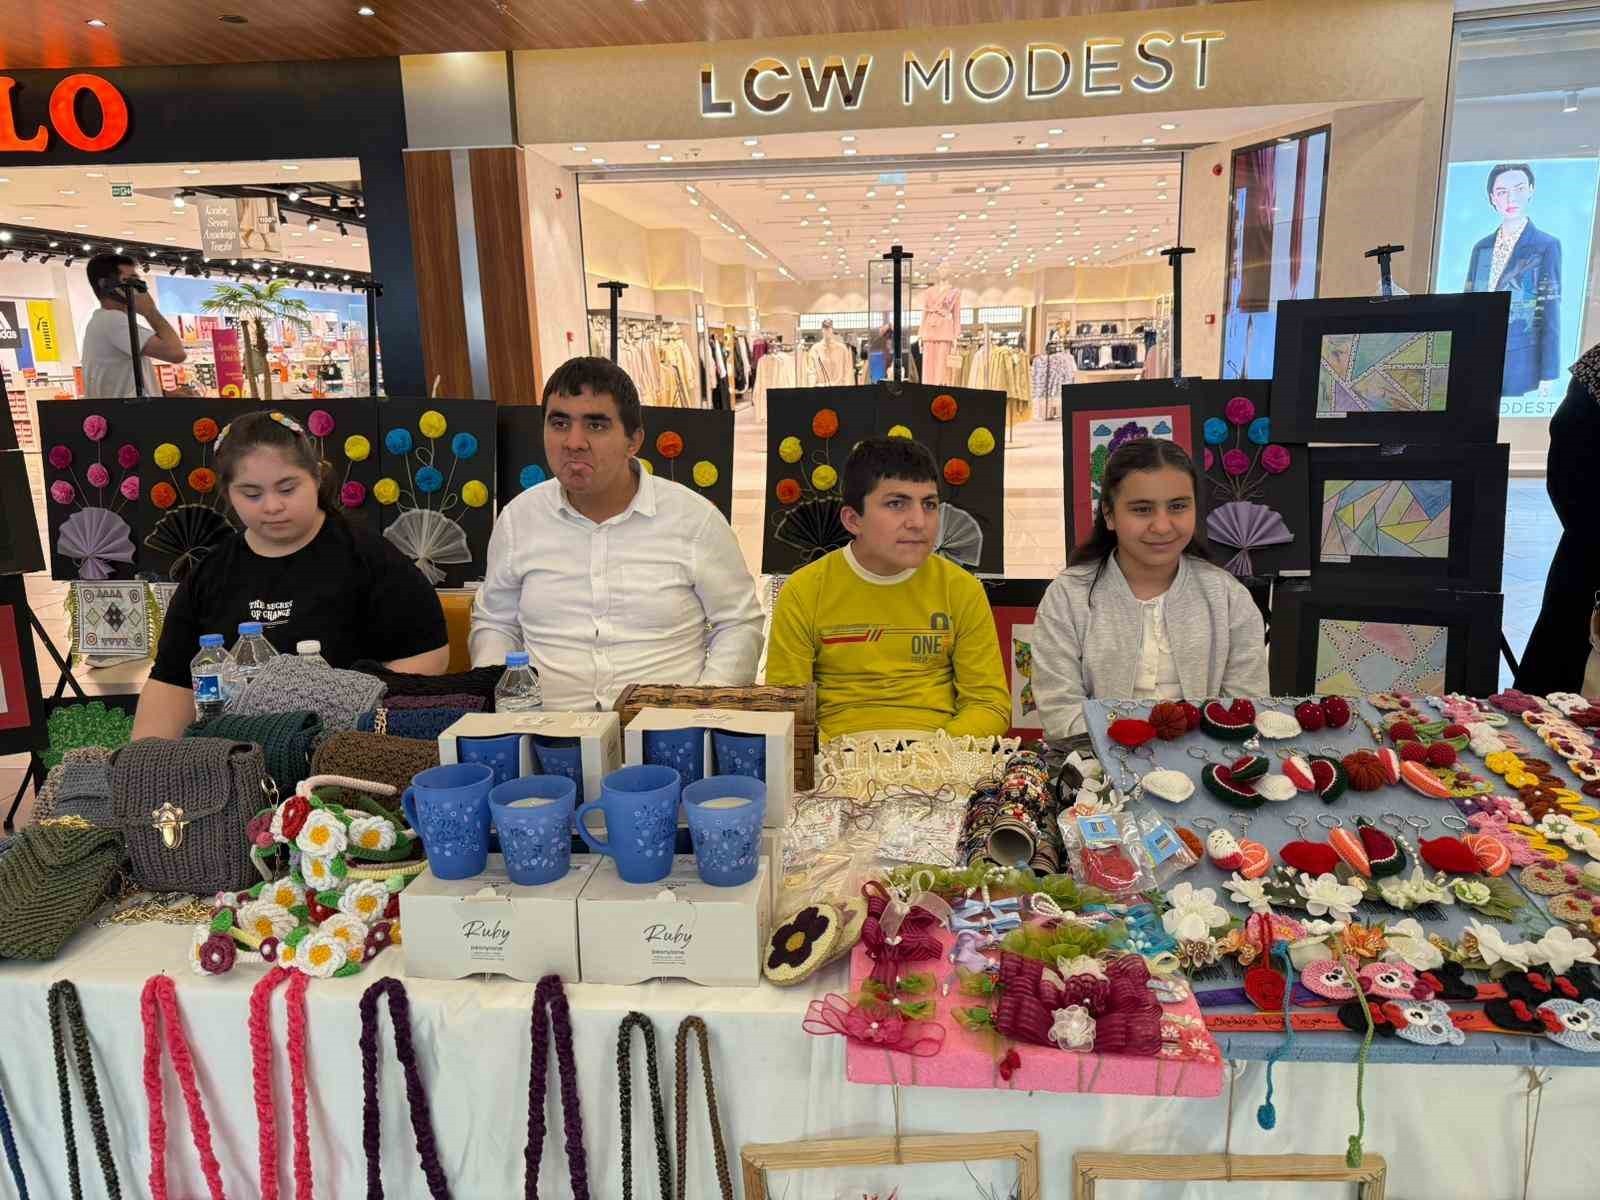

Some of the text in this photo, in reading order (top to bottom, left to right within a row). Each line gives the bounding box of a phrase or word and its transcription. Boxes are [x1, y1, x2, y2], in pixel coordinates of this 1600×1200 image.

[700, 31, 1226, 118] LCW MODEST
[911, 635, 943, 655] ONE
[462, 919, 511, 946] Ruby
[642, 923, 693, 949] Ruby
